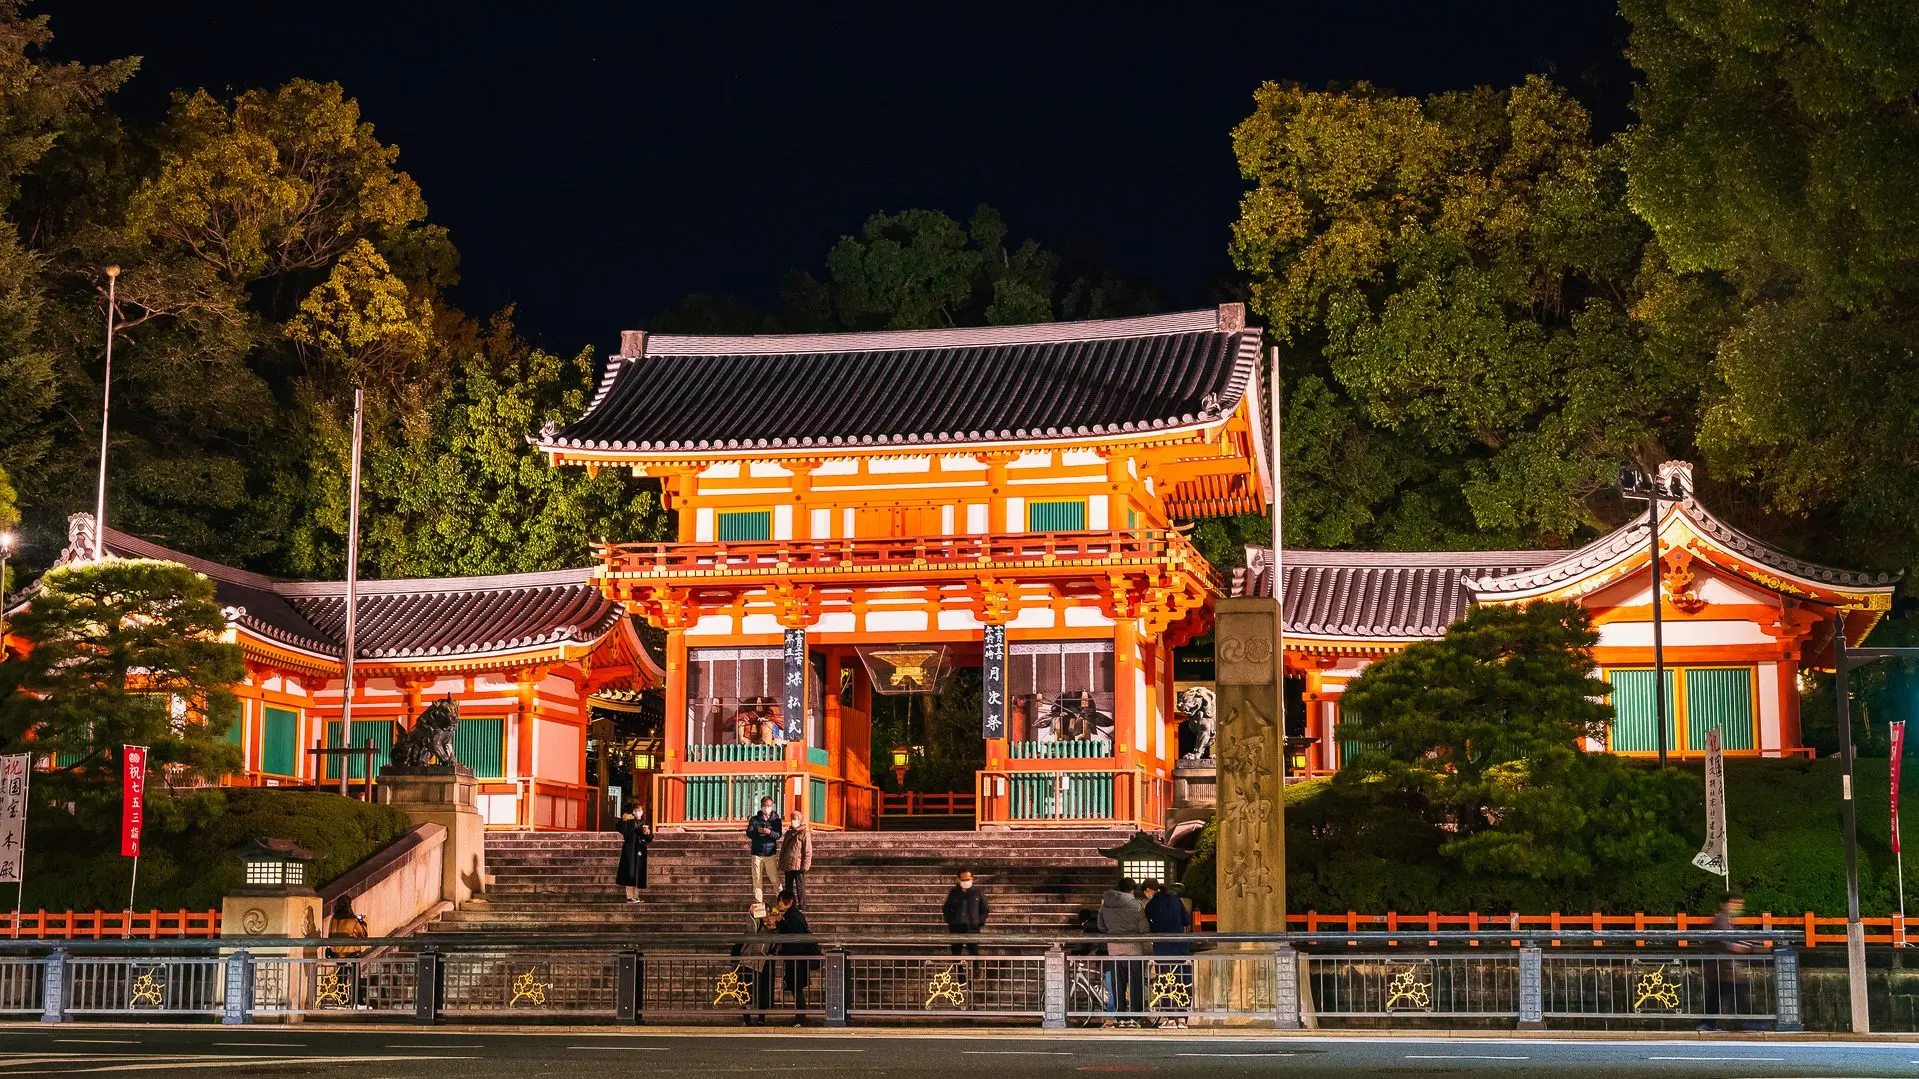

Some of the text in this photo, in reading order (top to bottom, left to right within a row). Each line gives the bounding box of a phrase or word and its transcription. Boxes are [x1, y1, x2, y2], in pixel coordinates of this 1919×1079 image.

[984, 625, 995, 661] 午前十時
[785, 671, 802, 734] 煤払式
[986, 667, 1002, 732] 月次祭
[0, 759, 22, 879] 祝国宝本殿
[129, 764, 141, 853] 祝七五三詣り
[1218, 699, 1274, 899] 八坂神社
